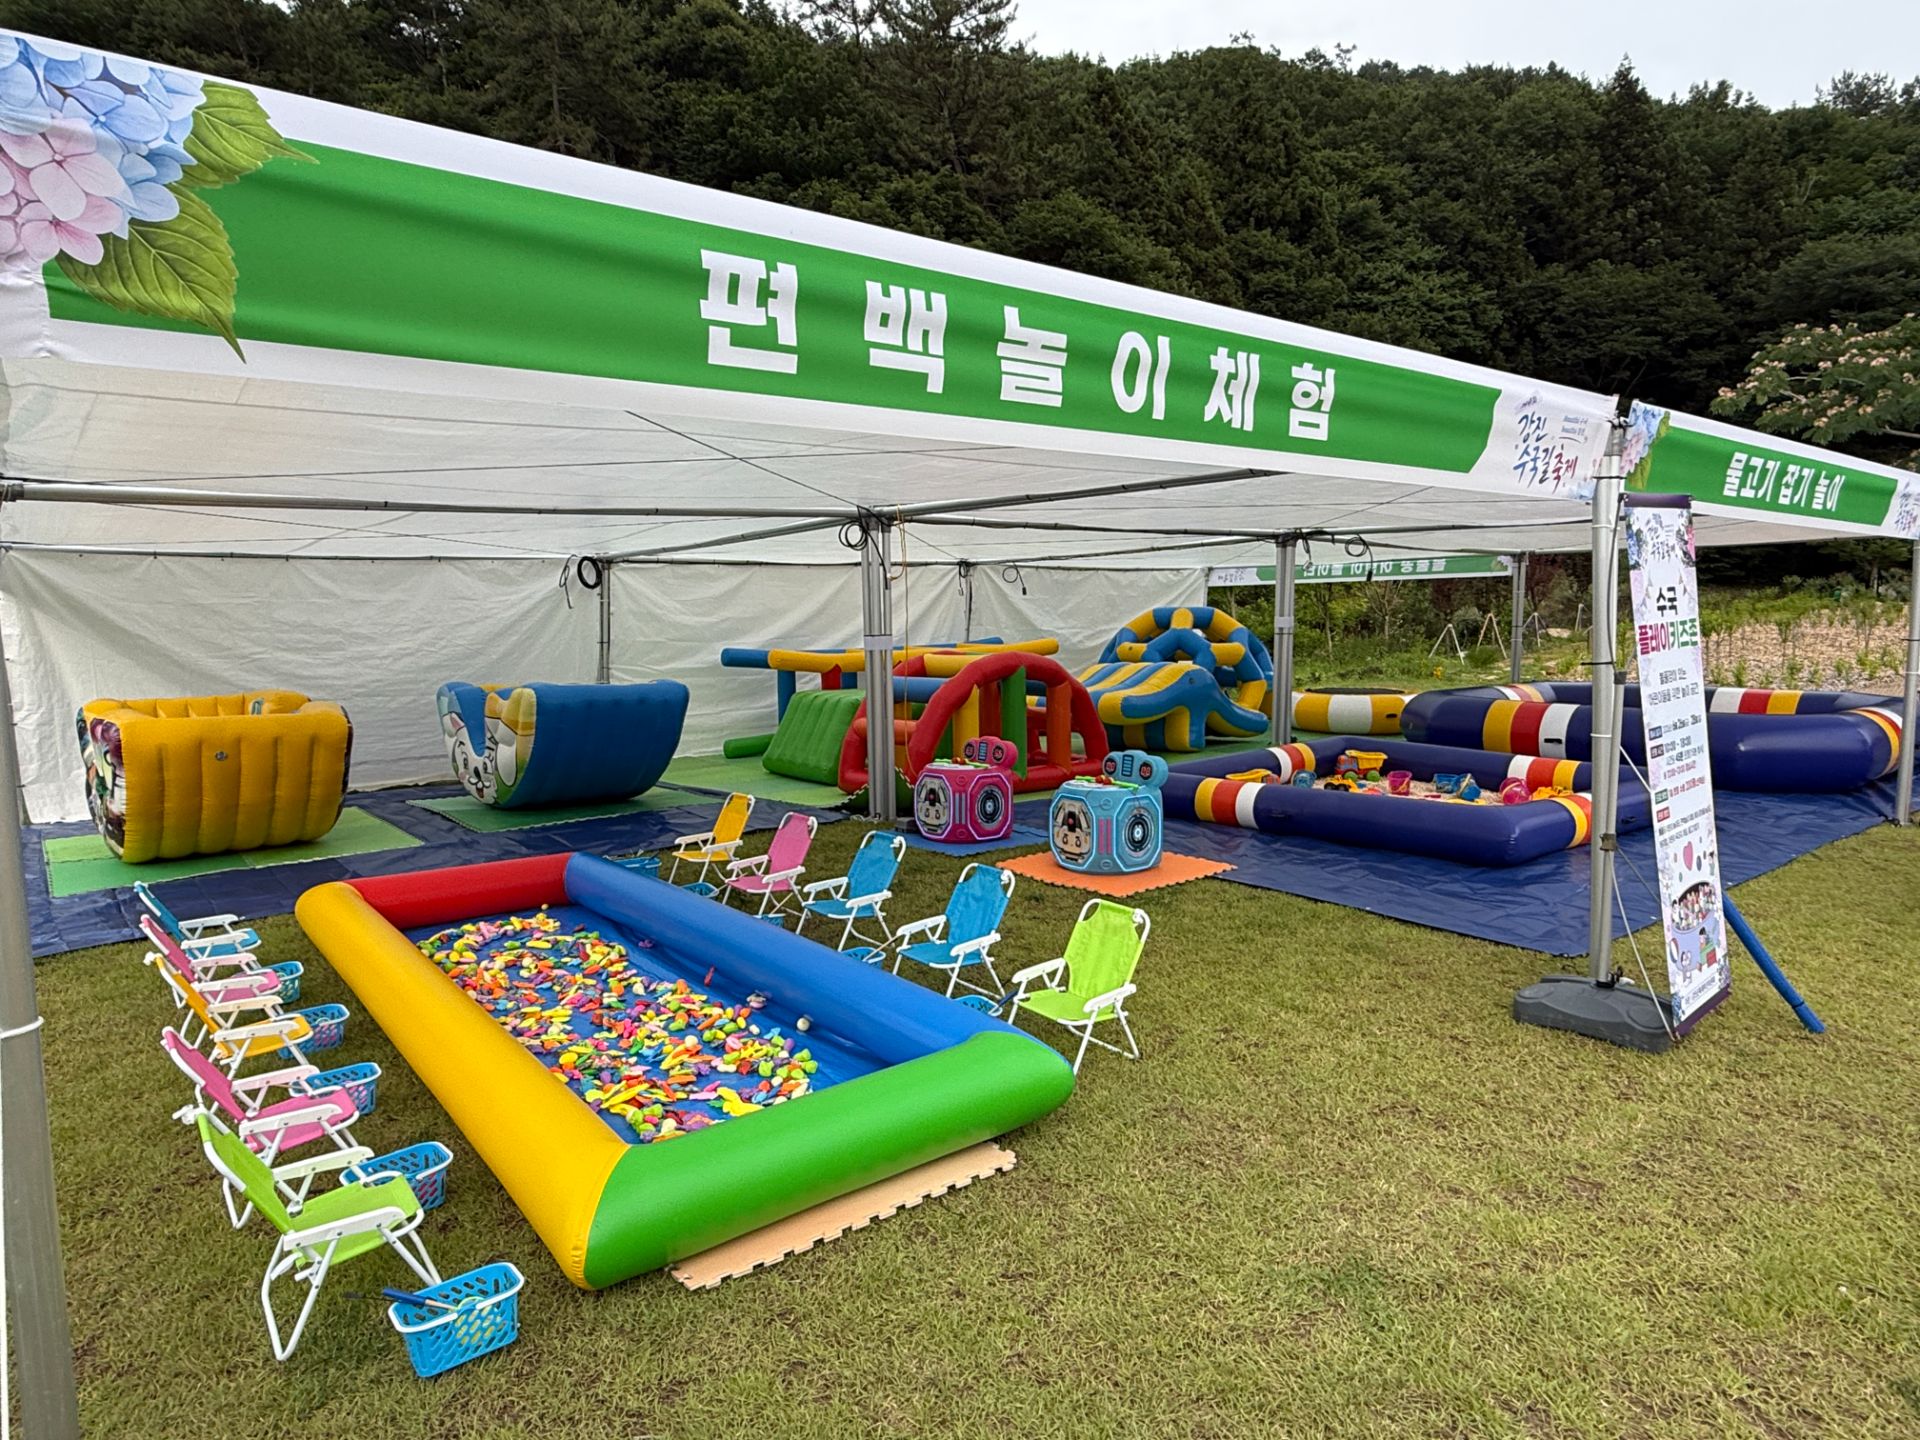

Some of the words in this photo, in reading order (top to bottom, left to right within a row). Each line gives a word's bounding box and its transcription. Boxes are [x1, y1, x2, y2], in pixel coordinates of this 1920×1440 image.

[1518, 411, 1548, 443] 강진
[1723, 451, 1781, 502] 물고기
[1778, 464, 1815, 507] 잡기
[1811, 470, 1846, 512] 놀이
[1656, 586, 1678, 617] 수국
